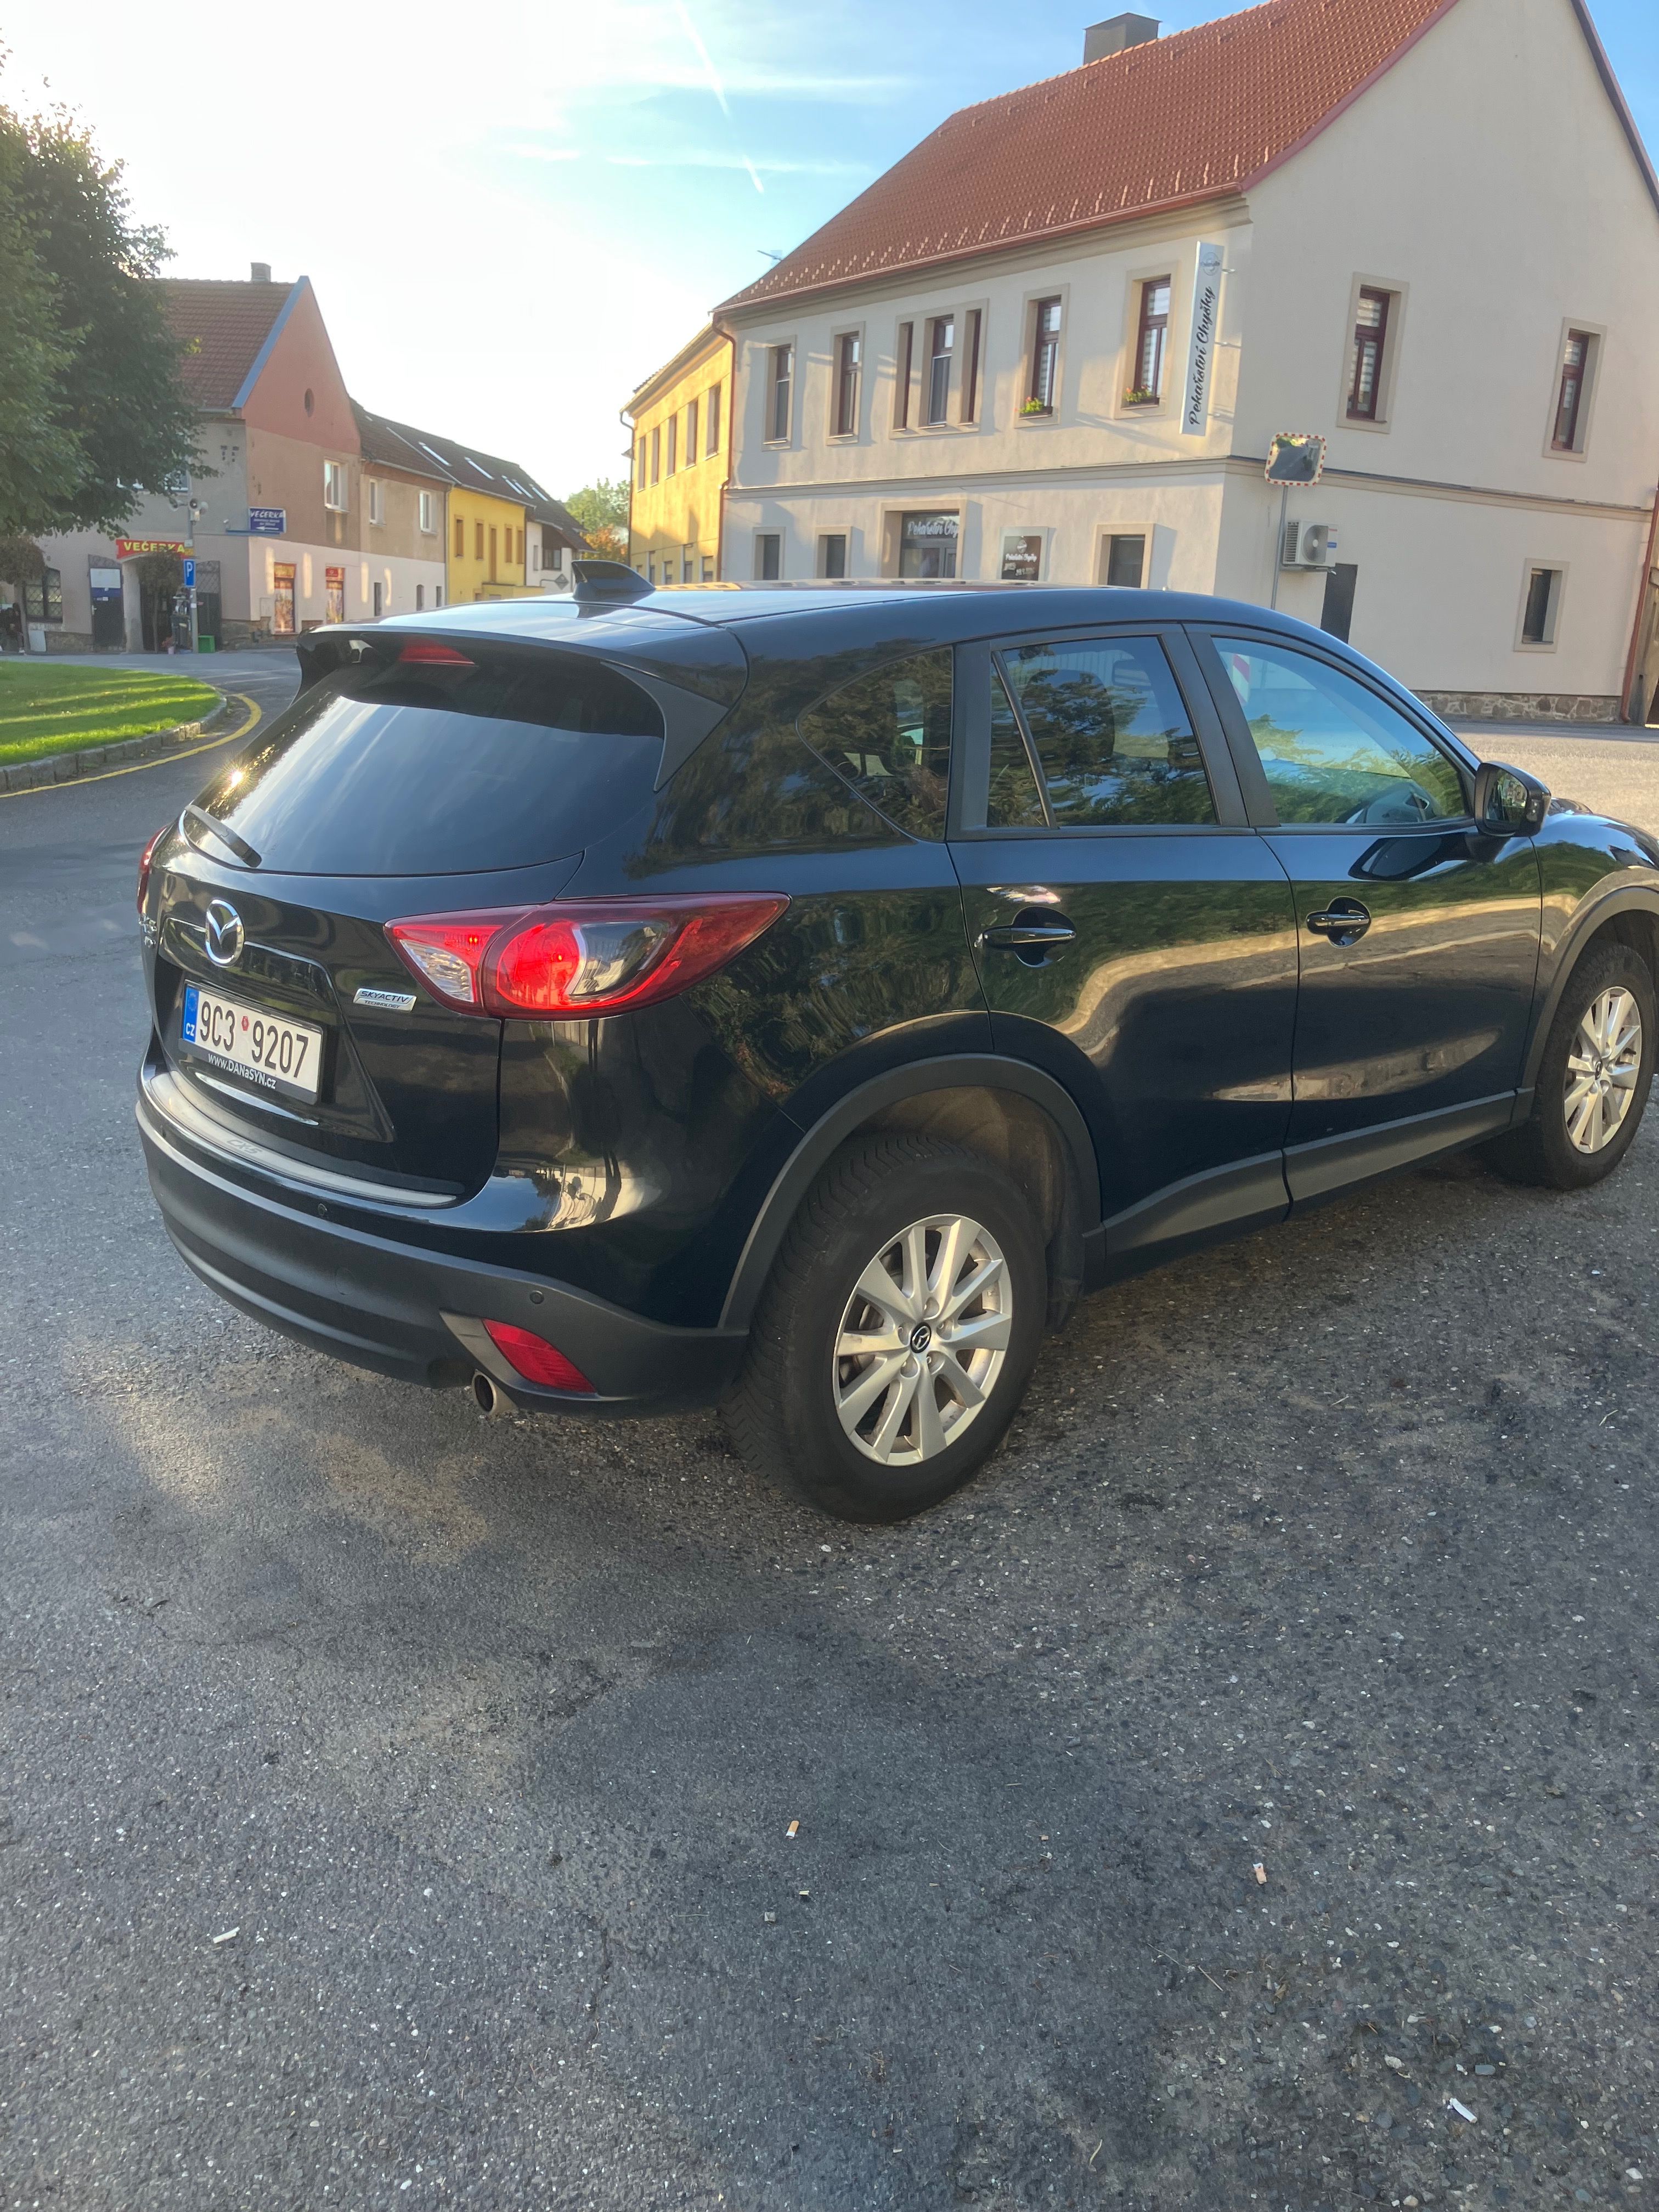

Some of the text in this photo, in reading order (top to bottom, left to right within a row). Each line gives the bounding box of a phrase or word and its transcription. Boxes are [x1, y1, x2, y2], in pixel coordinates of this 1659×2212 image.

[1197, 286, 1215, 344] Chyšky
[1188, 345, 1207, 425] Pekařství
[187, 562, 193, 577] P
[360, 991, 409, 1003] SKYACTIV
[364, 1000, 400, 1009] TECHNOLOGY
[185, 1022, 195, 1036] CZ
[200, 1001, 309, 1078] 9C3 9207
[208, 1053, 276, 1090] www.DANaSYN.cz
[227, 1139, 263, 1154] CX-5
